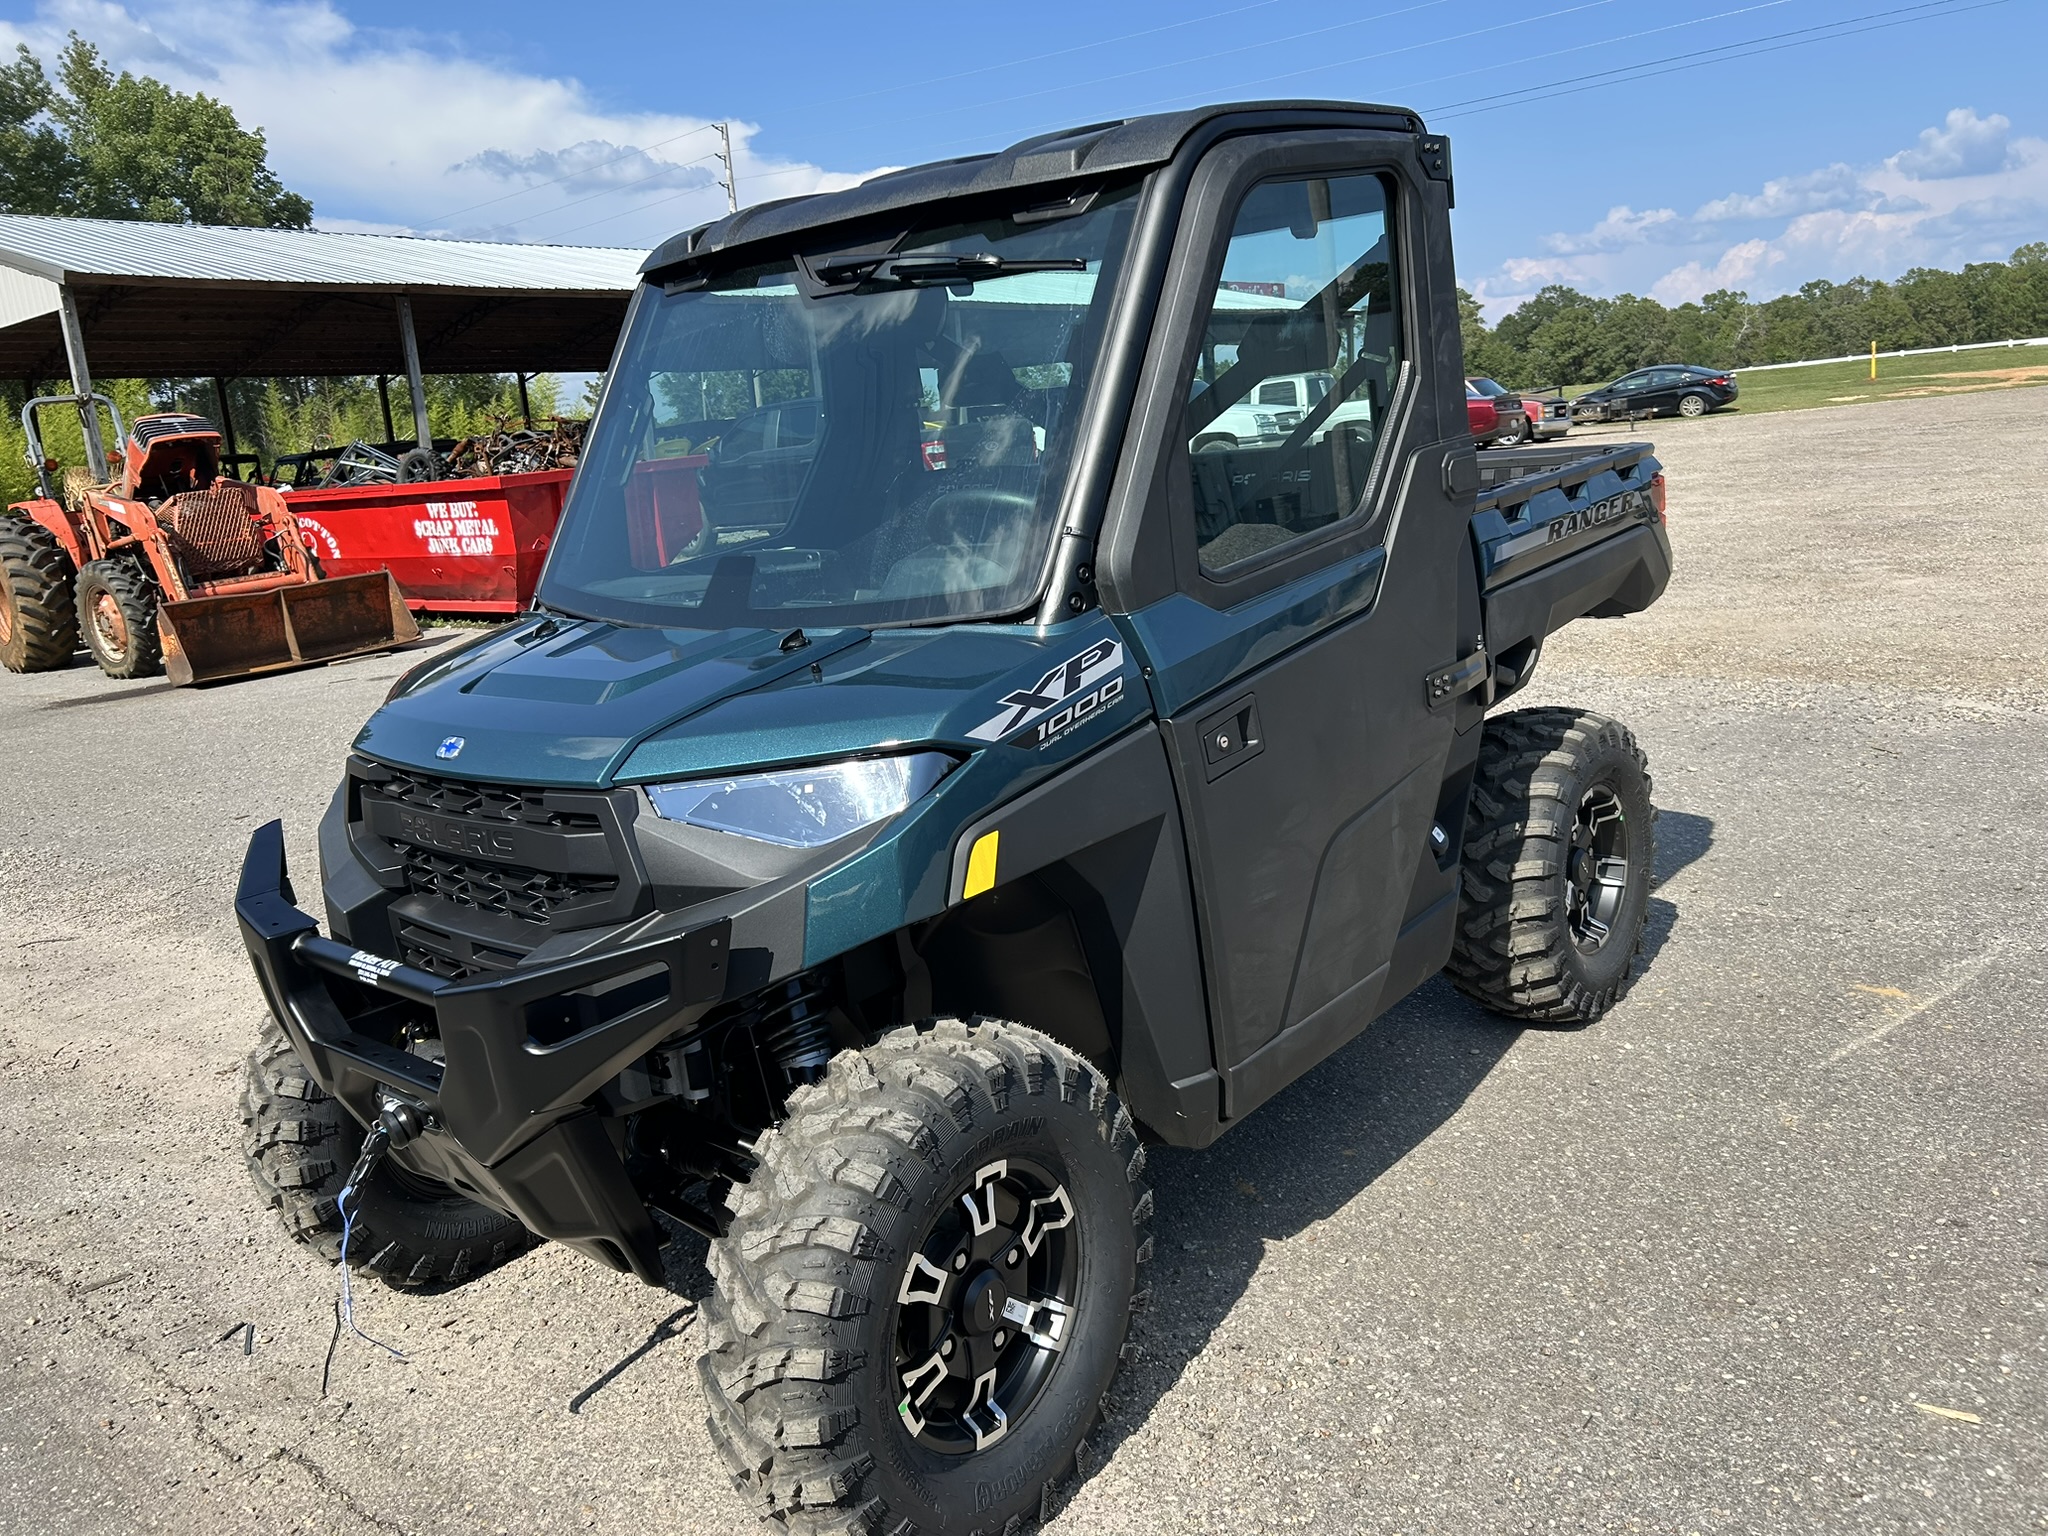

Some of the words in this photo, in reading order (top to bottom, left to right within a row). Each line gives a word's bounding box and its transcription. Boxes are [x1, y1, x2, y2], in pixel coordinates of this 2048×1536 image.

[414, 519, 454, 538] $CRAP
[454, 518, 499, 537] METAL
[426, 503, 449, 518] WE
[449, 501, 479, 518] BUY:
[1546, 490, 1635, 546] RANGER
[428, 537, 461, 554] JUNK
[461, 536, 494, 555] CAR$
[980, 638, 1122, 741] XP
[1036, 675, 1124, 742] 1000
[1039, 733, 1063, 751] DUAL
[1063, 705, 1106, 736] OVERHEAD
[1106, 693, 1124, 709] CAM
[400, 812, 516, 860] POLARIS
